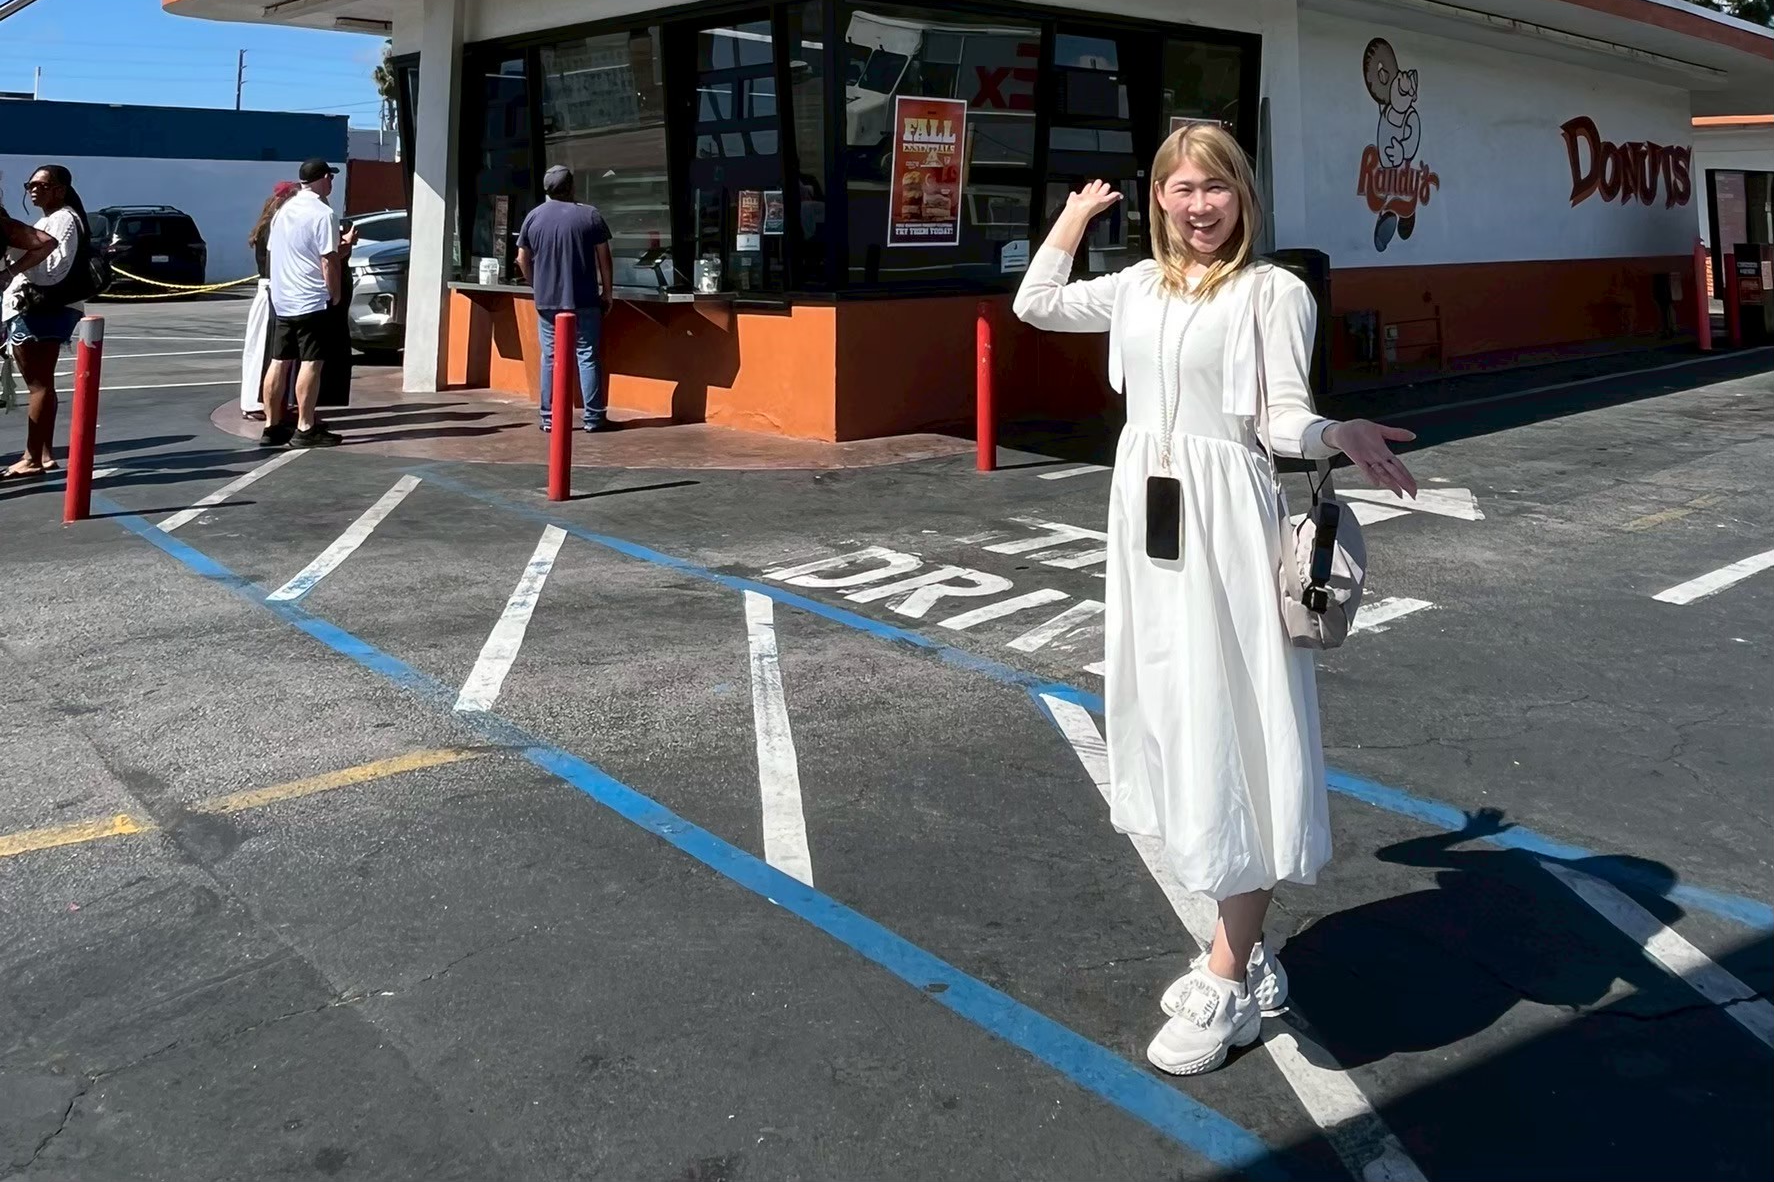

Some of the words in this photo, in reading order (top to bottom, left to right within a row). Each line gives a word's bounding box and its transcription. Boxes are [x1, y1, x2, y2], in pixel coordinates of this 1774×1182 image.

[903, 118, 957, 143] FALL
[1560, 116, 1692, 209] DONUTS
[1357, 144, 1440, 218] Randy's
